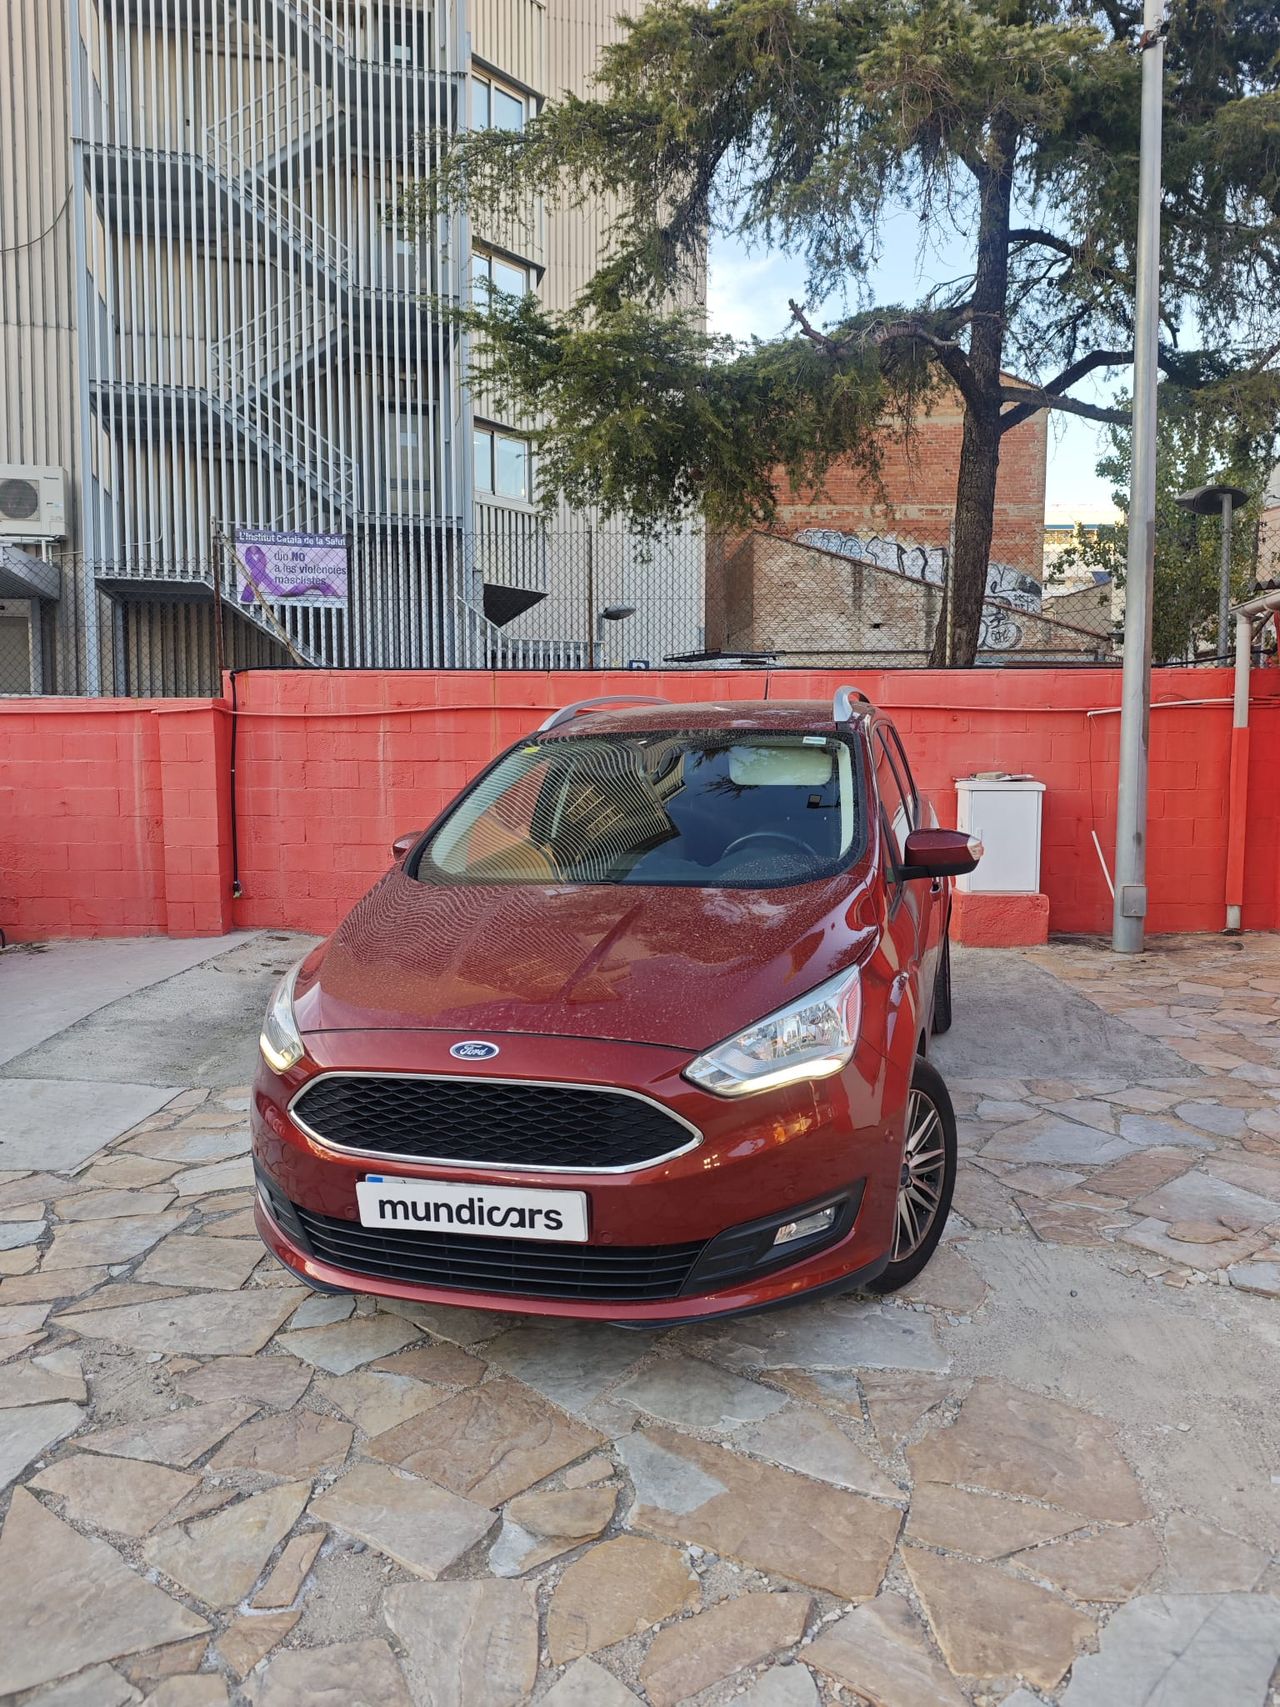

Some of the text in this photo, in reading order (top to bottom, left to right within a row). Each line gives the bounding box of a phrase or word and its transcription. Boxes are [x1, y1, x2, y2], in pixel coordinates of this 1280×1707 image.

[239, 531, 275, 542] L'Institut
[304, 537, 314, 545] de
[316, 537, 324, 545] la
[325, 537, 346, 546] Salut
[291, 551, 305, 562] NO
[274, 564, 280, 572] a
[283, 563, 297, 573] les
[274, 575, 326, 585] masclistes
[459, 1044, 488, 1055] Ford
[378, 1197, 563, 1231] mundicars
